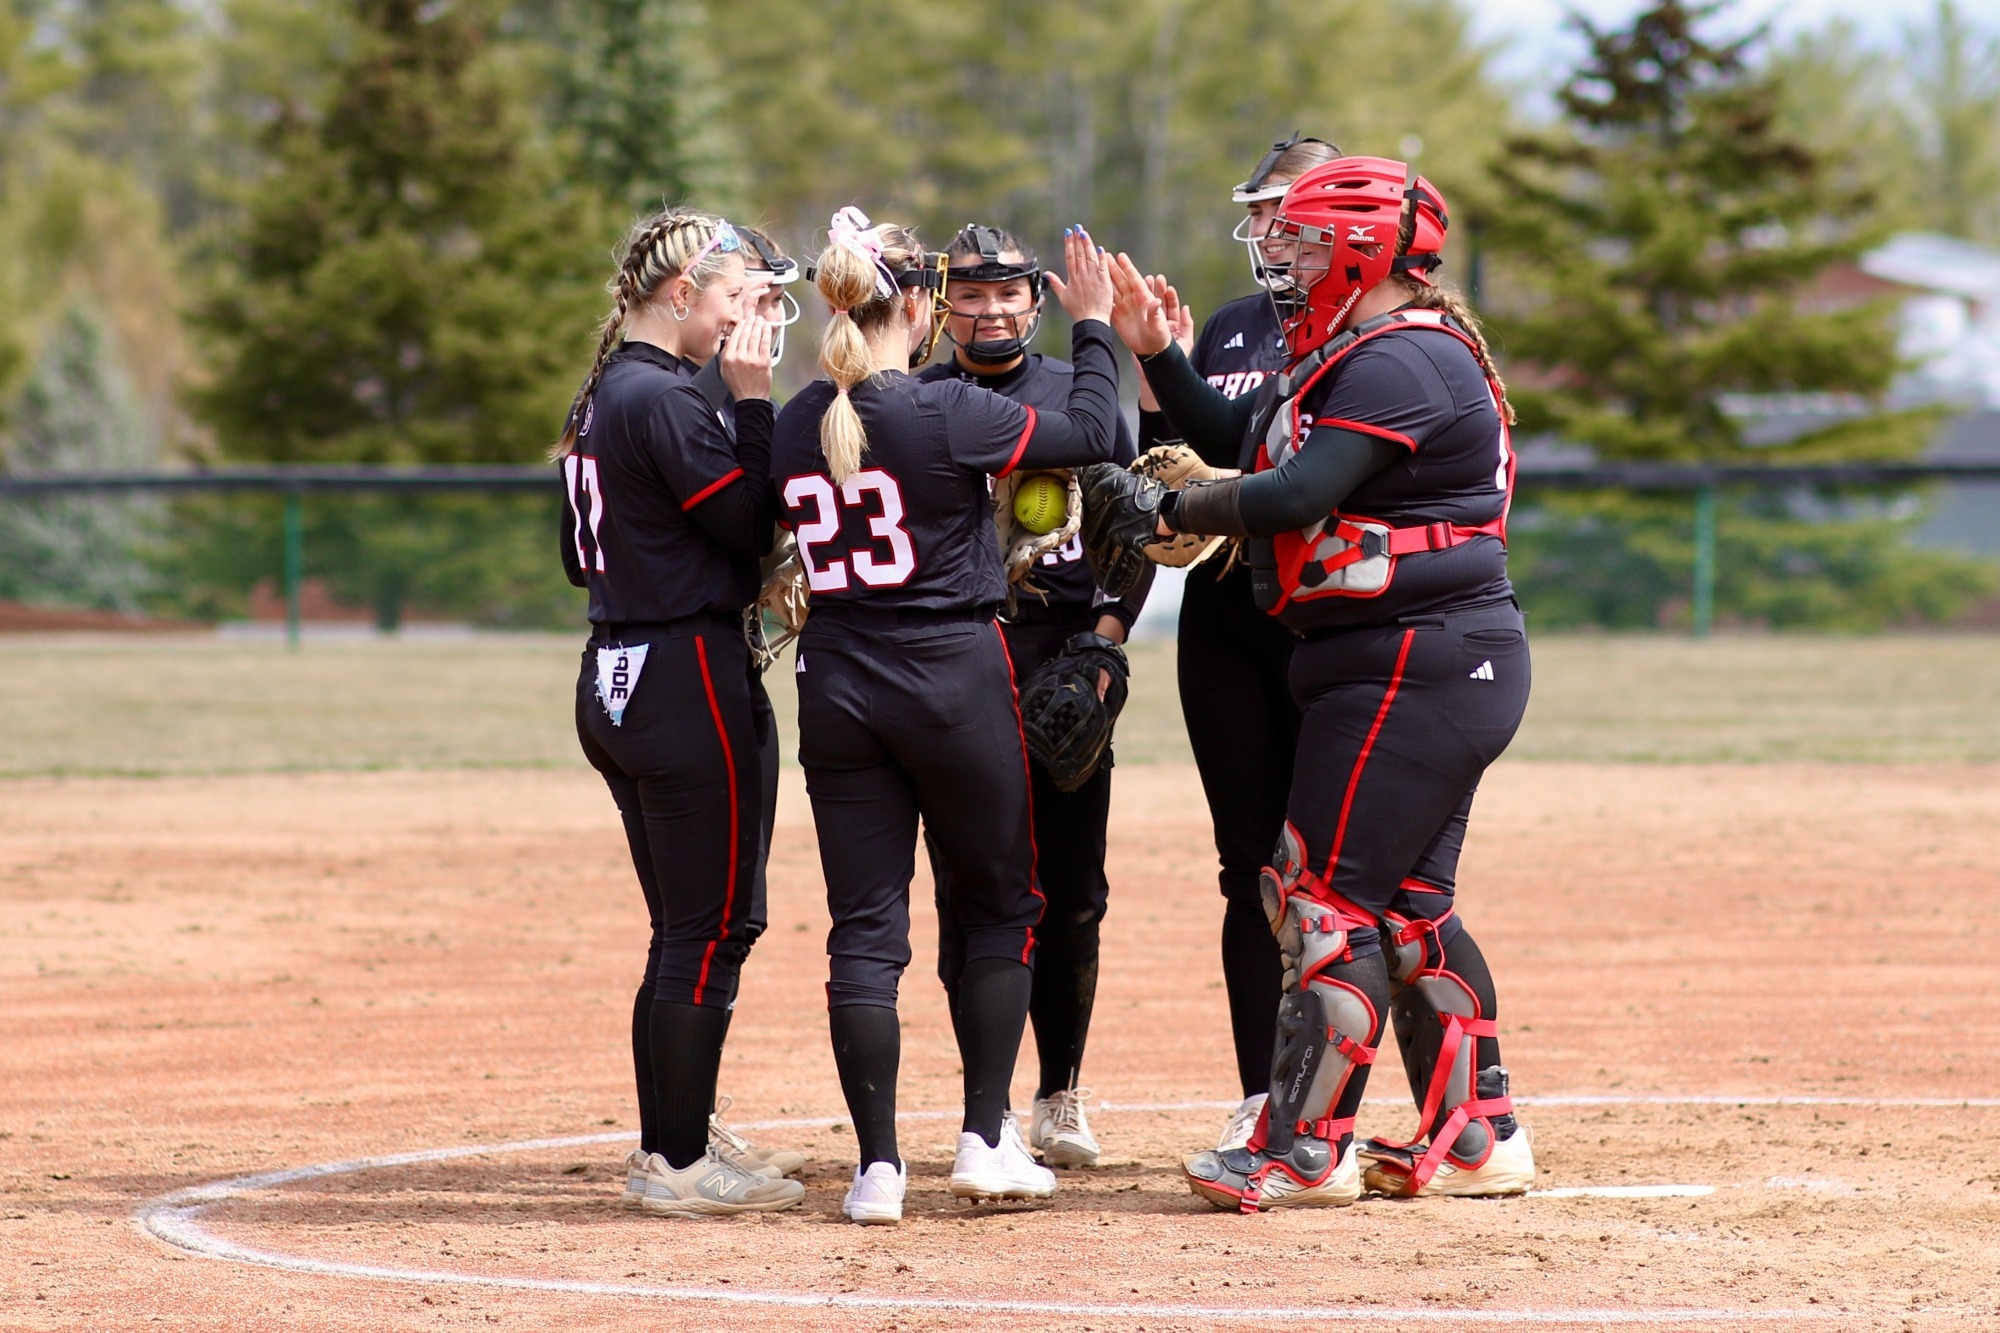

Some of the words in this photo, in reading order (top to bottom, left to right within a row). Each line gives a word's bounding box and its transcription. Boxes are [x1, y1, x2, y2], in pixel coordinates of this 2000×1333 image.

[1326, 286, 1362, 336] SAMURAI
[564, 451, 606, 574] 17
[782, 466, 918, 594] 23
[1288, 1045, 1314, 1104] samurai
